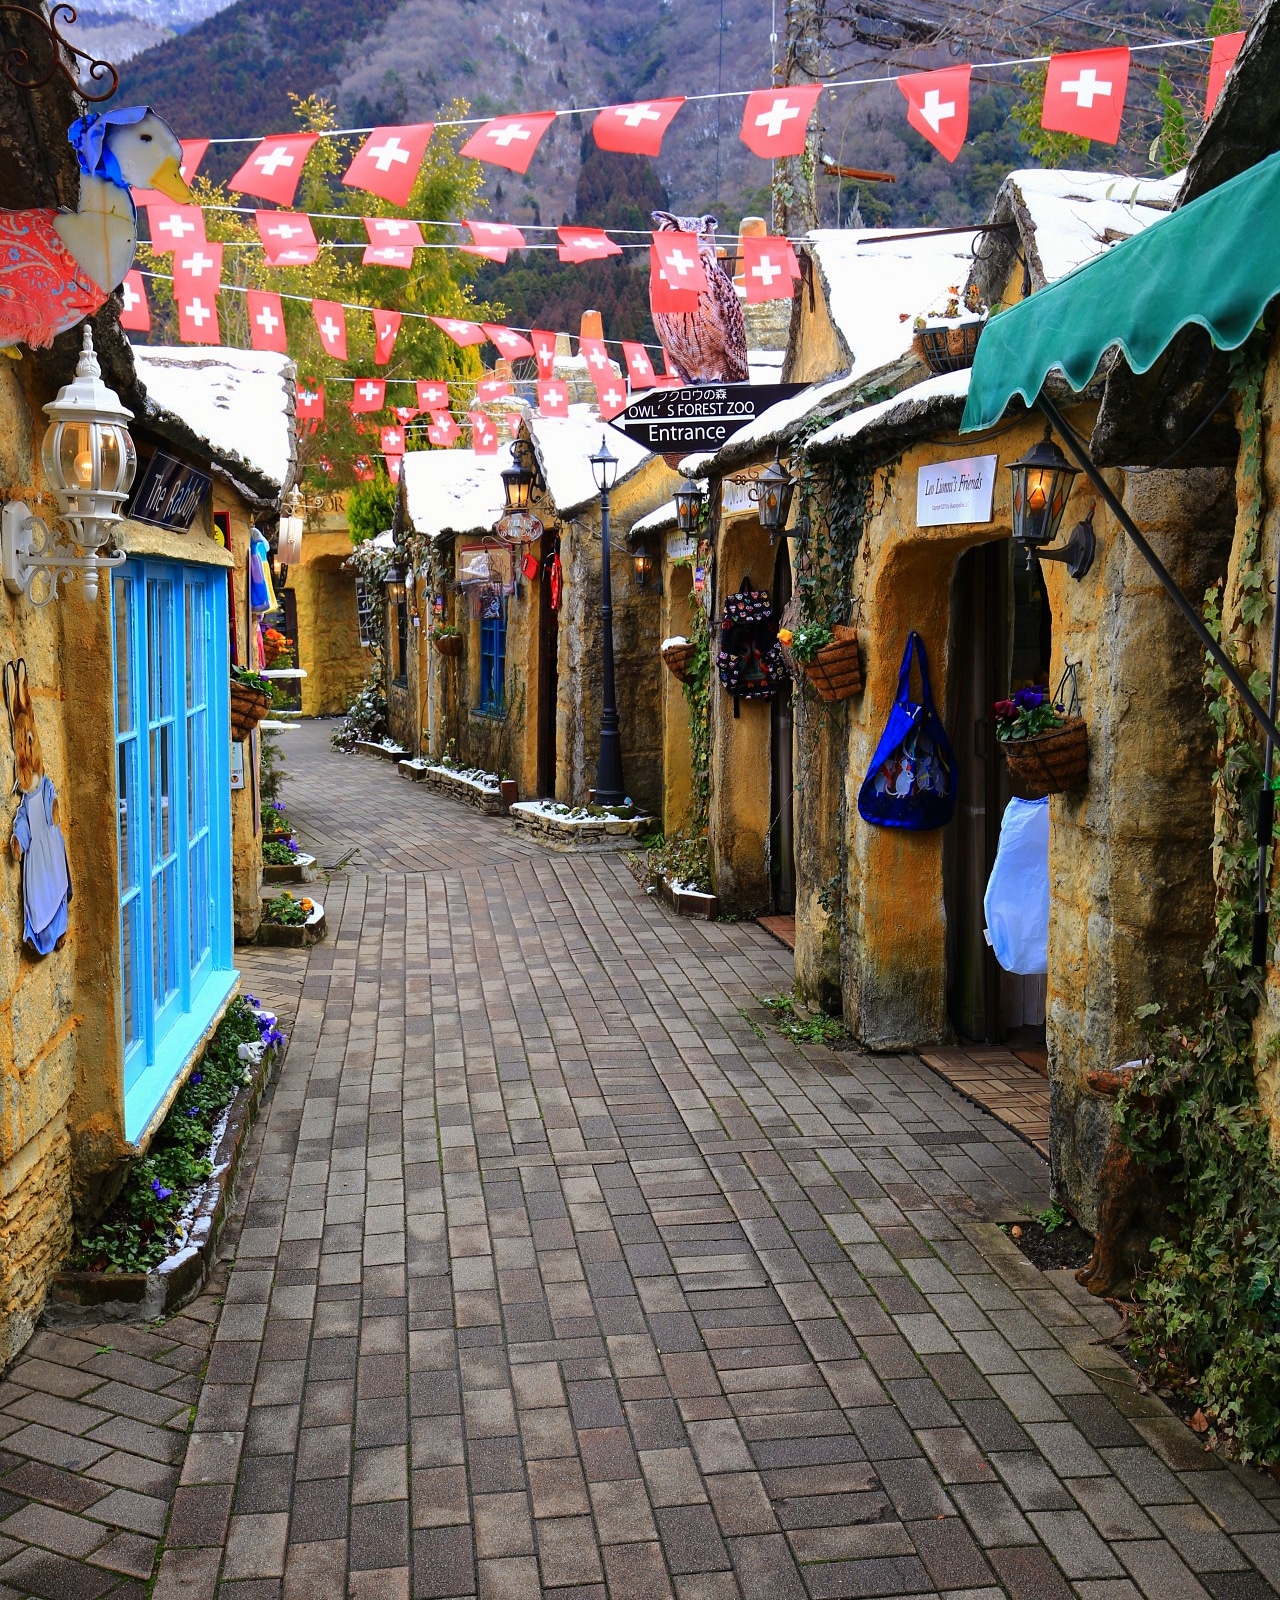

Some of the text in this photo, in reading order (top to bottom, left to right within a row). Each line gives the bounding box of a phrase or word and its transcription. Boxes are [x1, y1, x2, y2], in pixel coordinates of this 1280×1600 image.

[658, 388, 727, 403] フクロウの森
[677, 402, 724, 416] FOREST
[727, 400, 755, 415] ZOO
[648, 424, 726, 442] Entrance
[958, 472, 983, 492] Friends
[145, 473, 205, 527] The Rabbit
